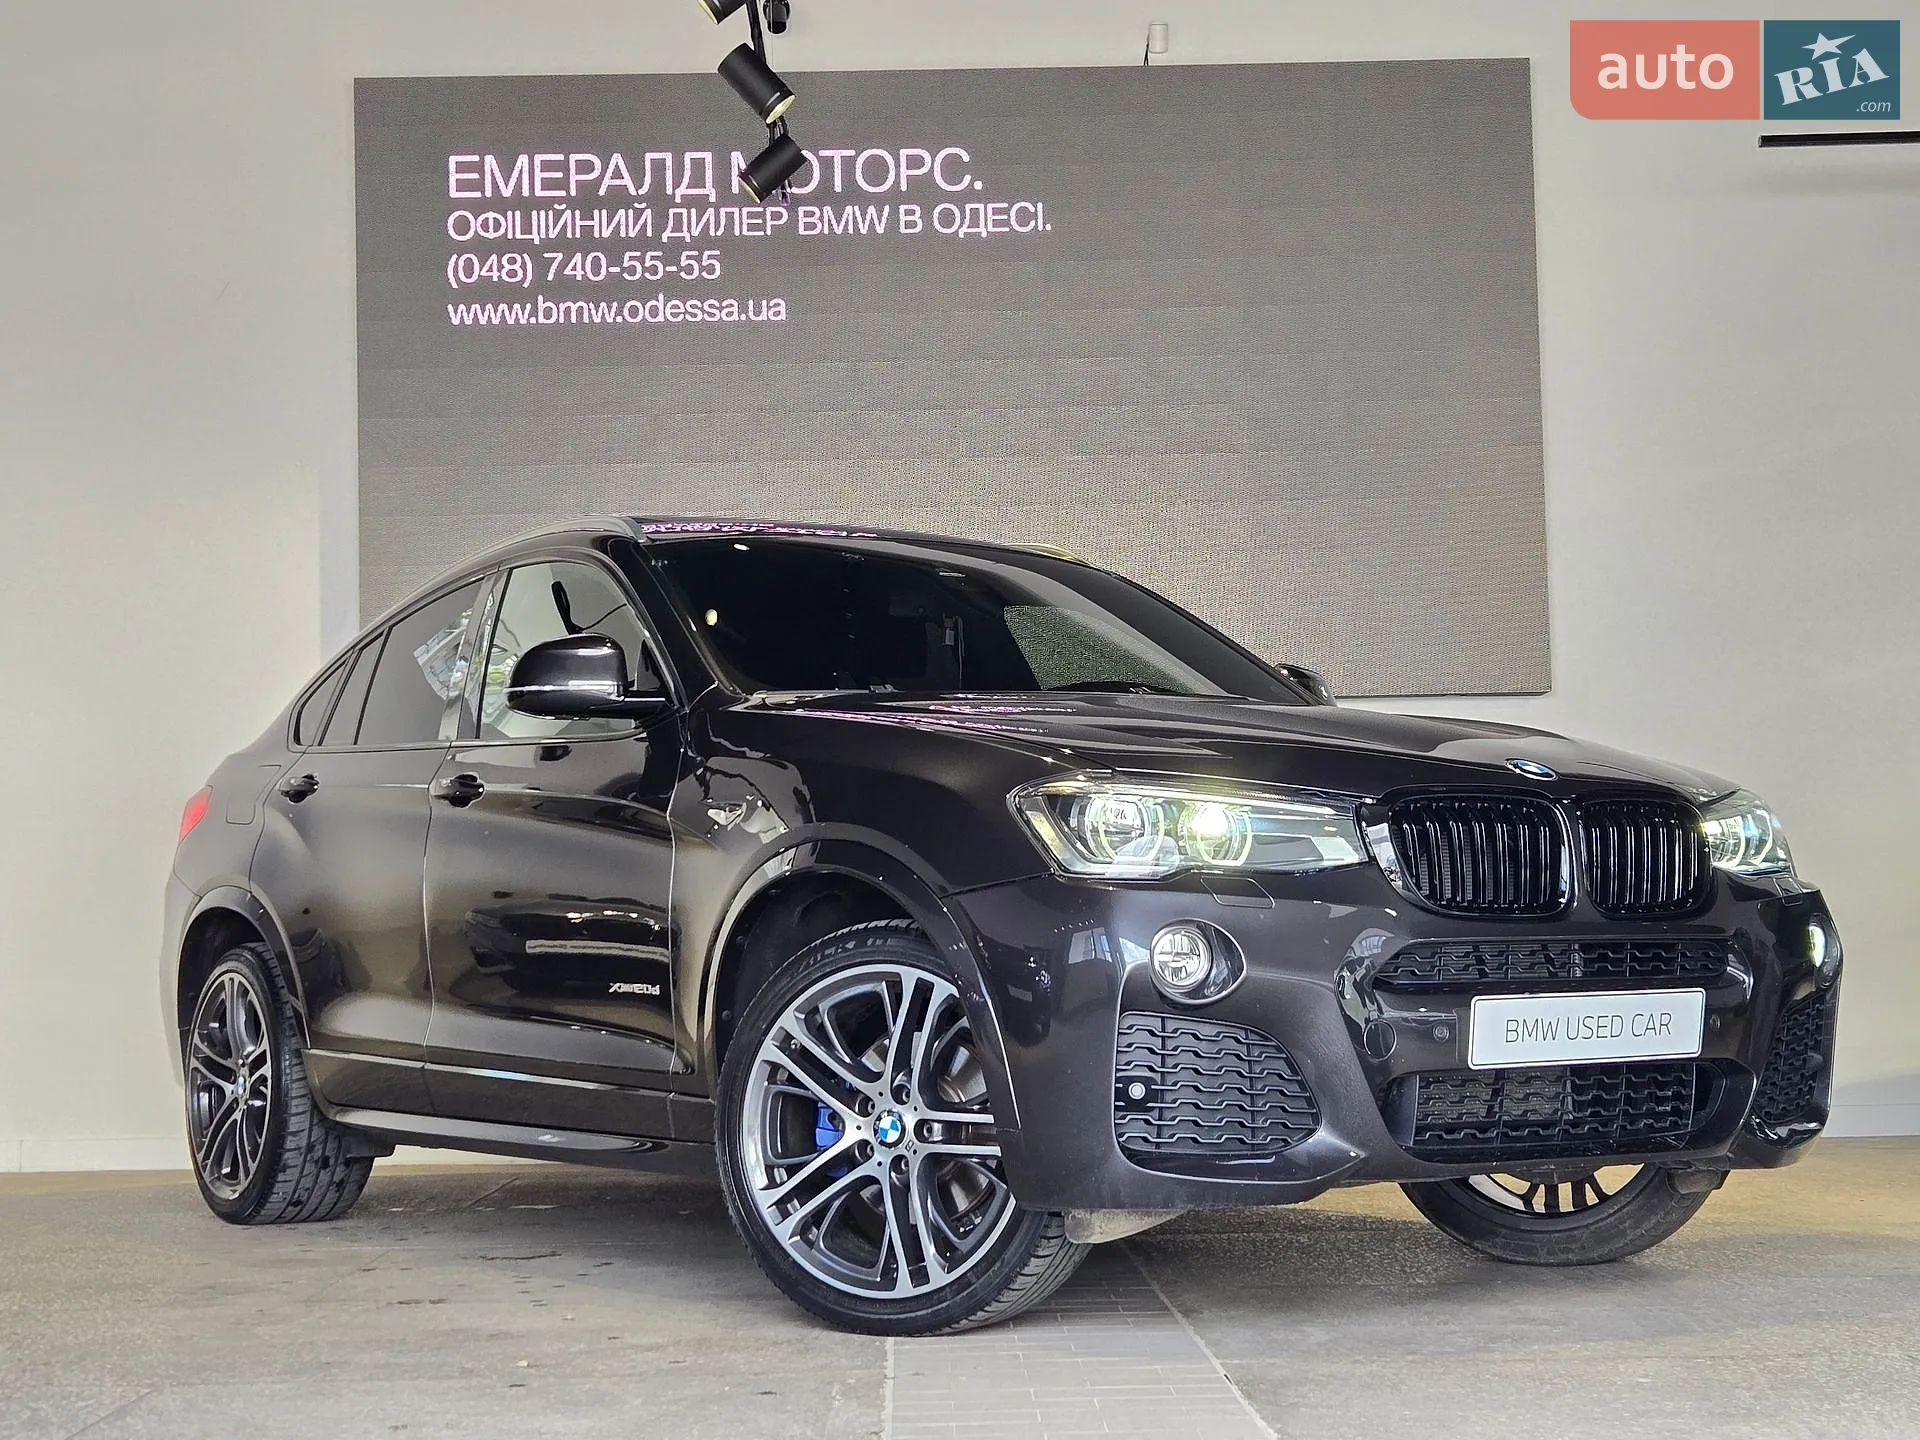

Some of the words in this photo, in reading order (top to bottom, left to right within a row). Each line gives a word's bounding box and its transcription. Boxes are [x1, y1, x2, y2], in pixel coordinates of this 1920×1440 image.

[449, 152, 716, 203] ЕМЕРАЛД
[448, 203, 652, 244] ОФІЦІЙНИЙ
[662, 206, 789, 242] ДИЛЕР
[798, 205, 890, 235] BMW
[899, 205, 923, 234] В
[933, 202, 1052, 238] ОДЕСІ.
[447, 252, 533, 288] (048)
[543, 250, 721, 282] 740-55-55
[448, 293, 787, 326] www.bmw.odessa.ua
[1505, 1017, 1560, 1043] BMW
[1566, 1015, 1624, 1040] USED
[1631, 1012, 1672, 1037] CAR
